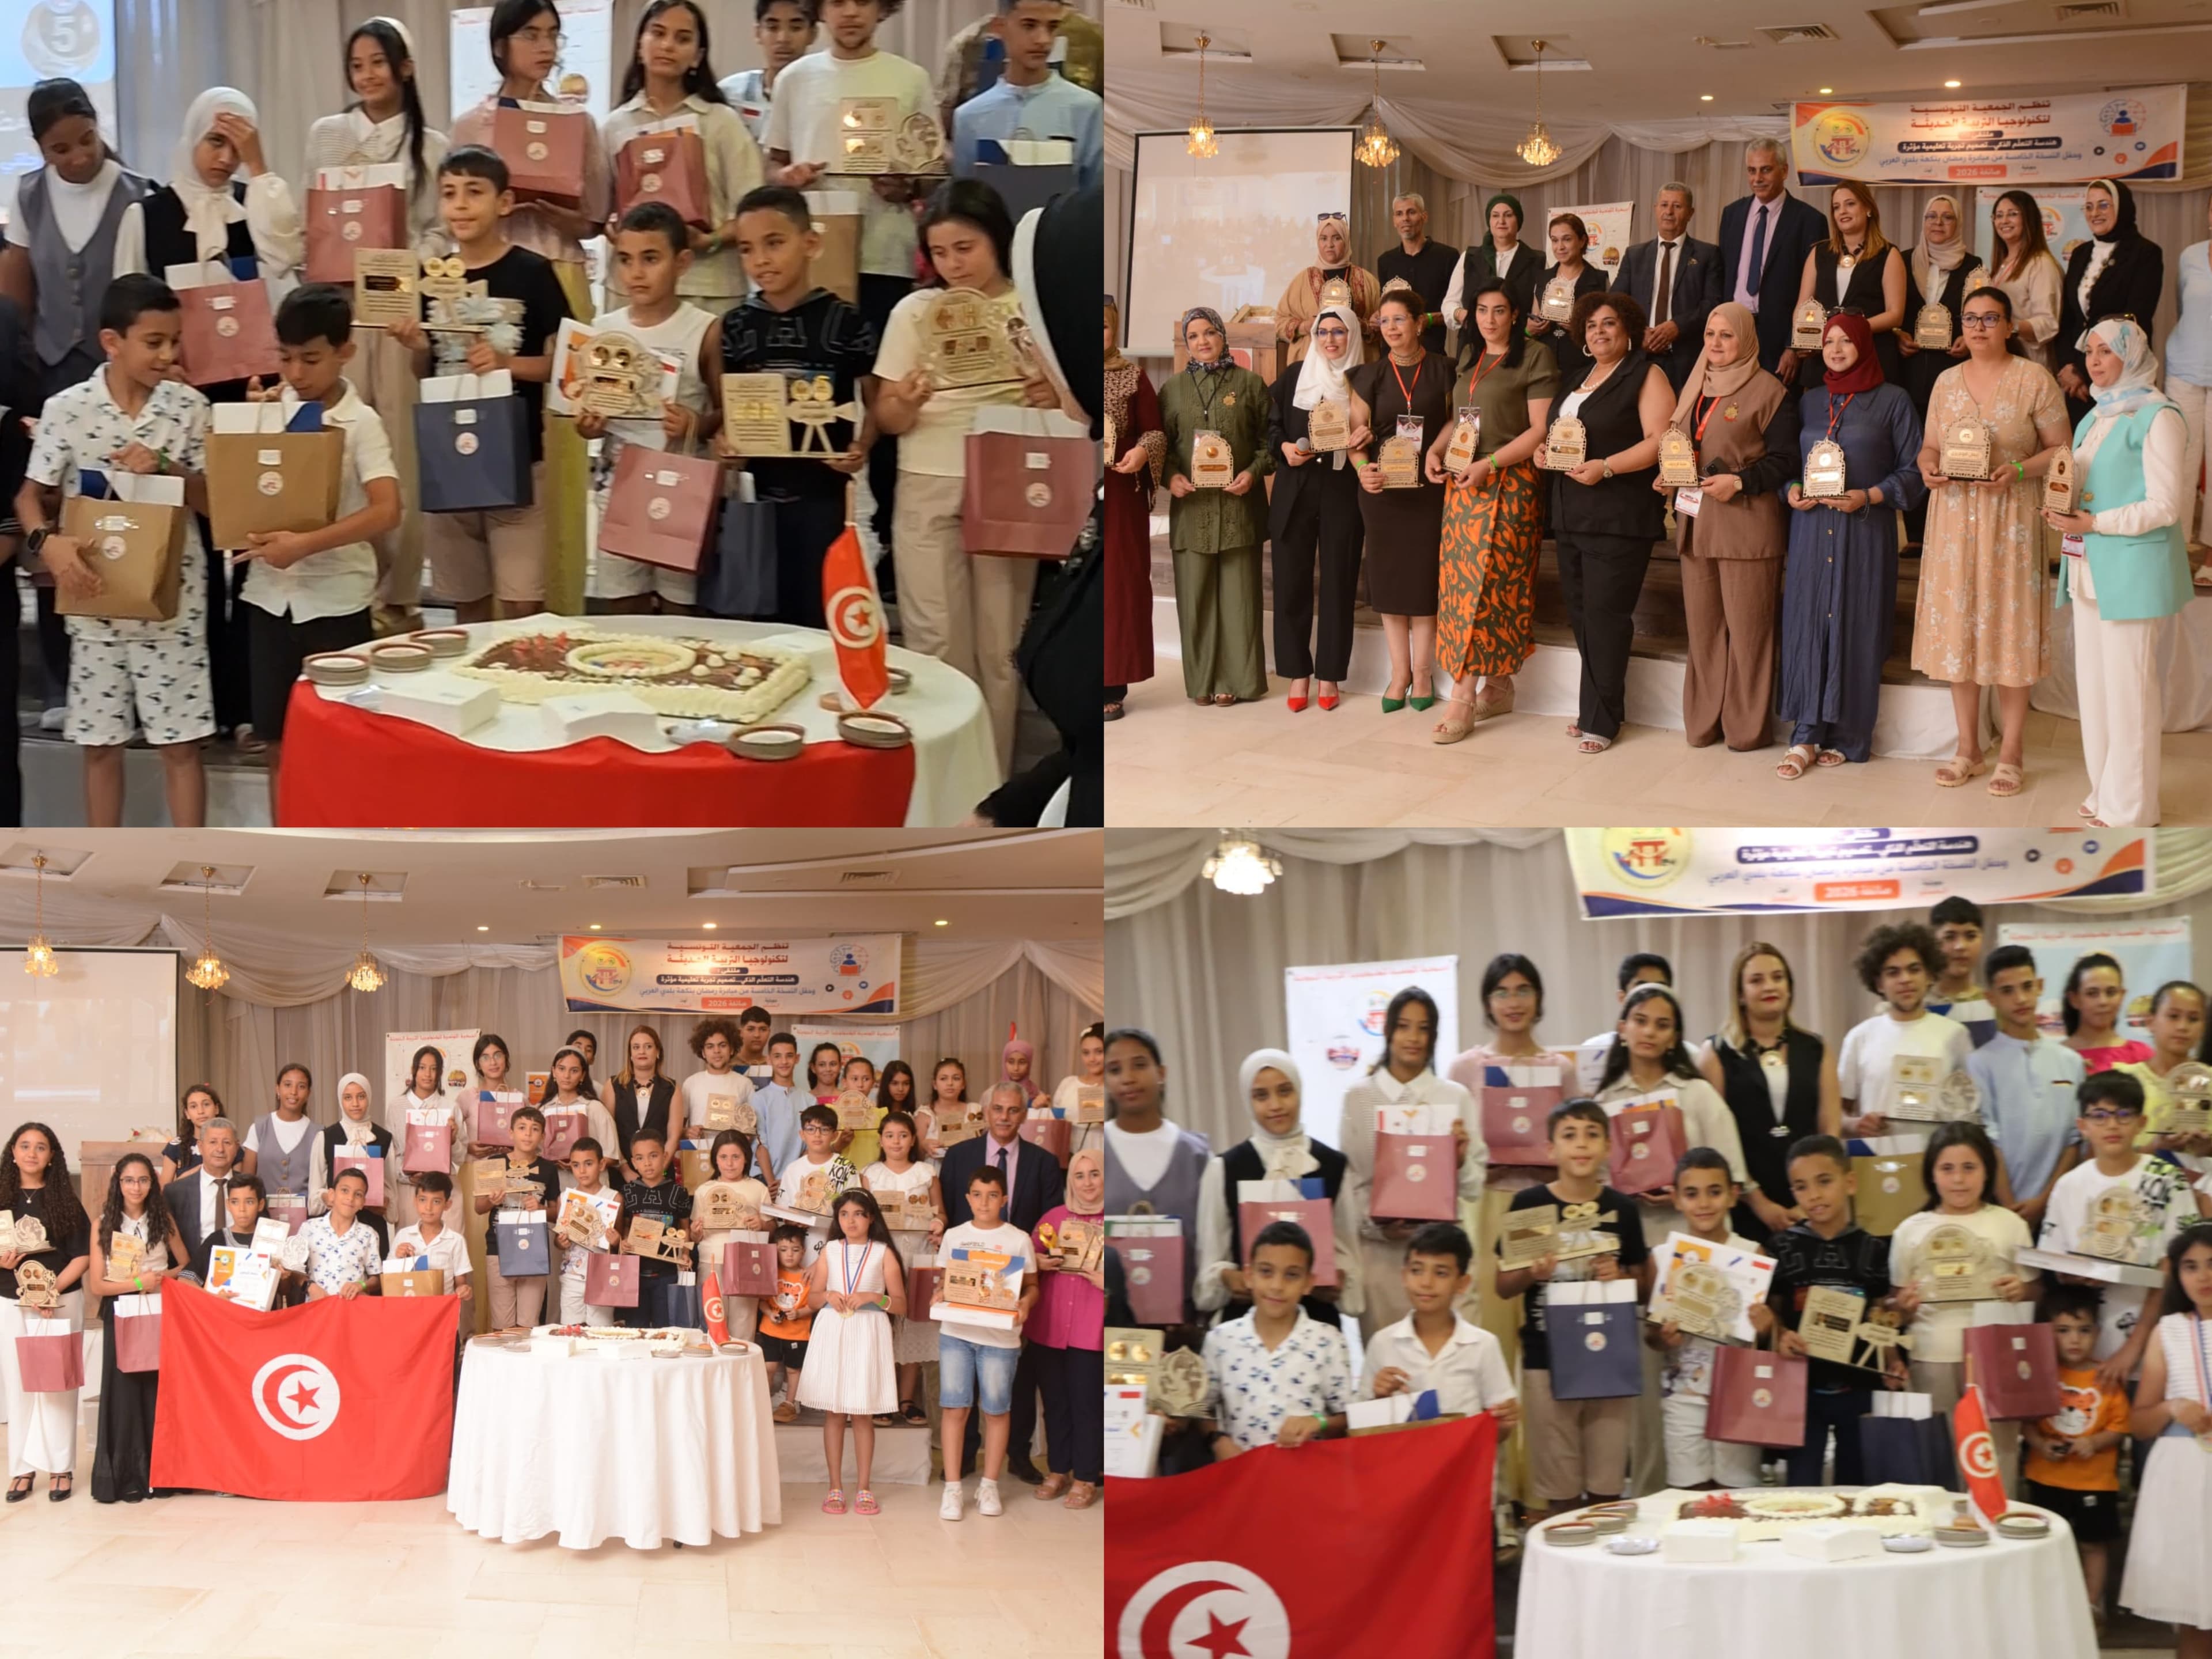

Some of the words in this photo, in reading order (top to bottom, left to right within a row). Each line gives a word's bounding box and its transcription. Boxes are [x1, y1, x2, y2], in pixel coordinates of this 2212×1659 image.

[51, 16, 77, 52] 5
[1972, 103, 2015, 113] الجمعية
[722, 943, 759, 952] الجمعية
